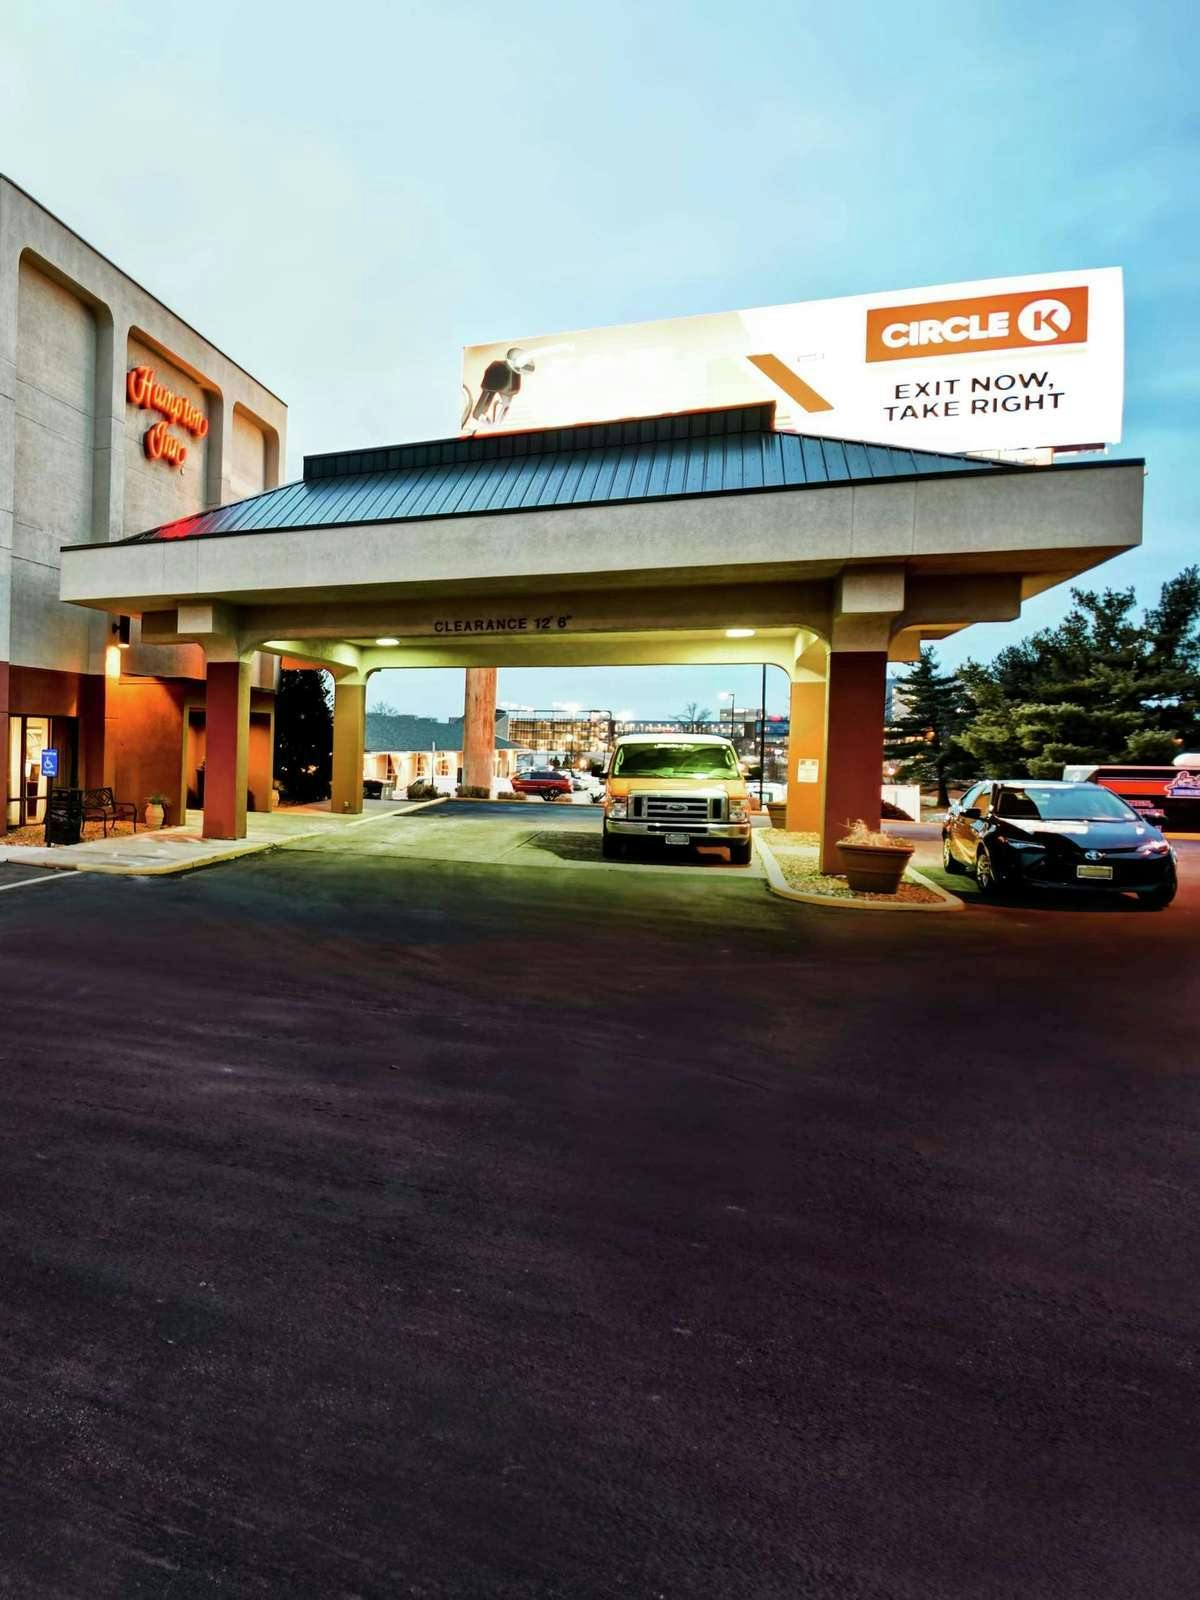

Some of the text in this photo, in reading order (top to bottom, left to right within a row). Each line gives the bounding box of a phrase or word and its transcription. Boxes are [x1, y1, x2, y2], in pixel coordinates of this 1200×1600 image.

[881, 303, 1071, 348] CIRCLE K
[894, 371, 1054, 399] EXIT NOW,
[127, 366, 209, 438] Hampton
[884, 392, 1065, 421] TAKE RIGHT
[434, 617, 528, 632] CLEARANCE
